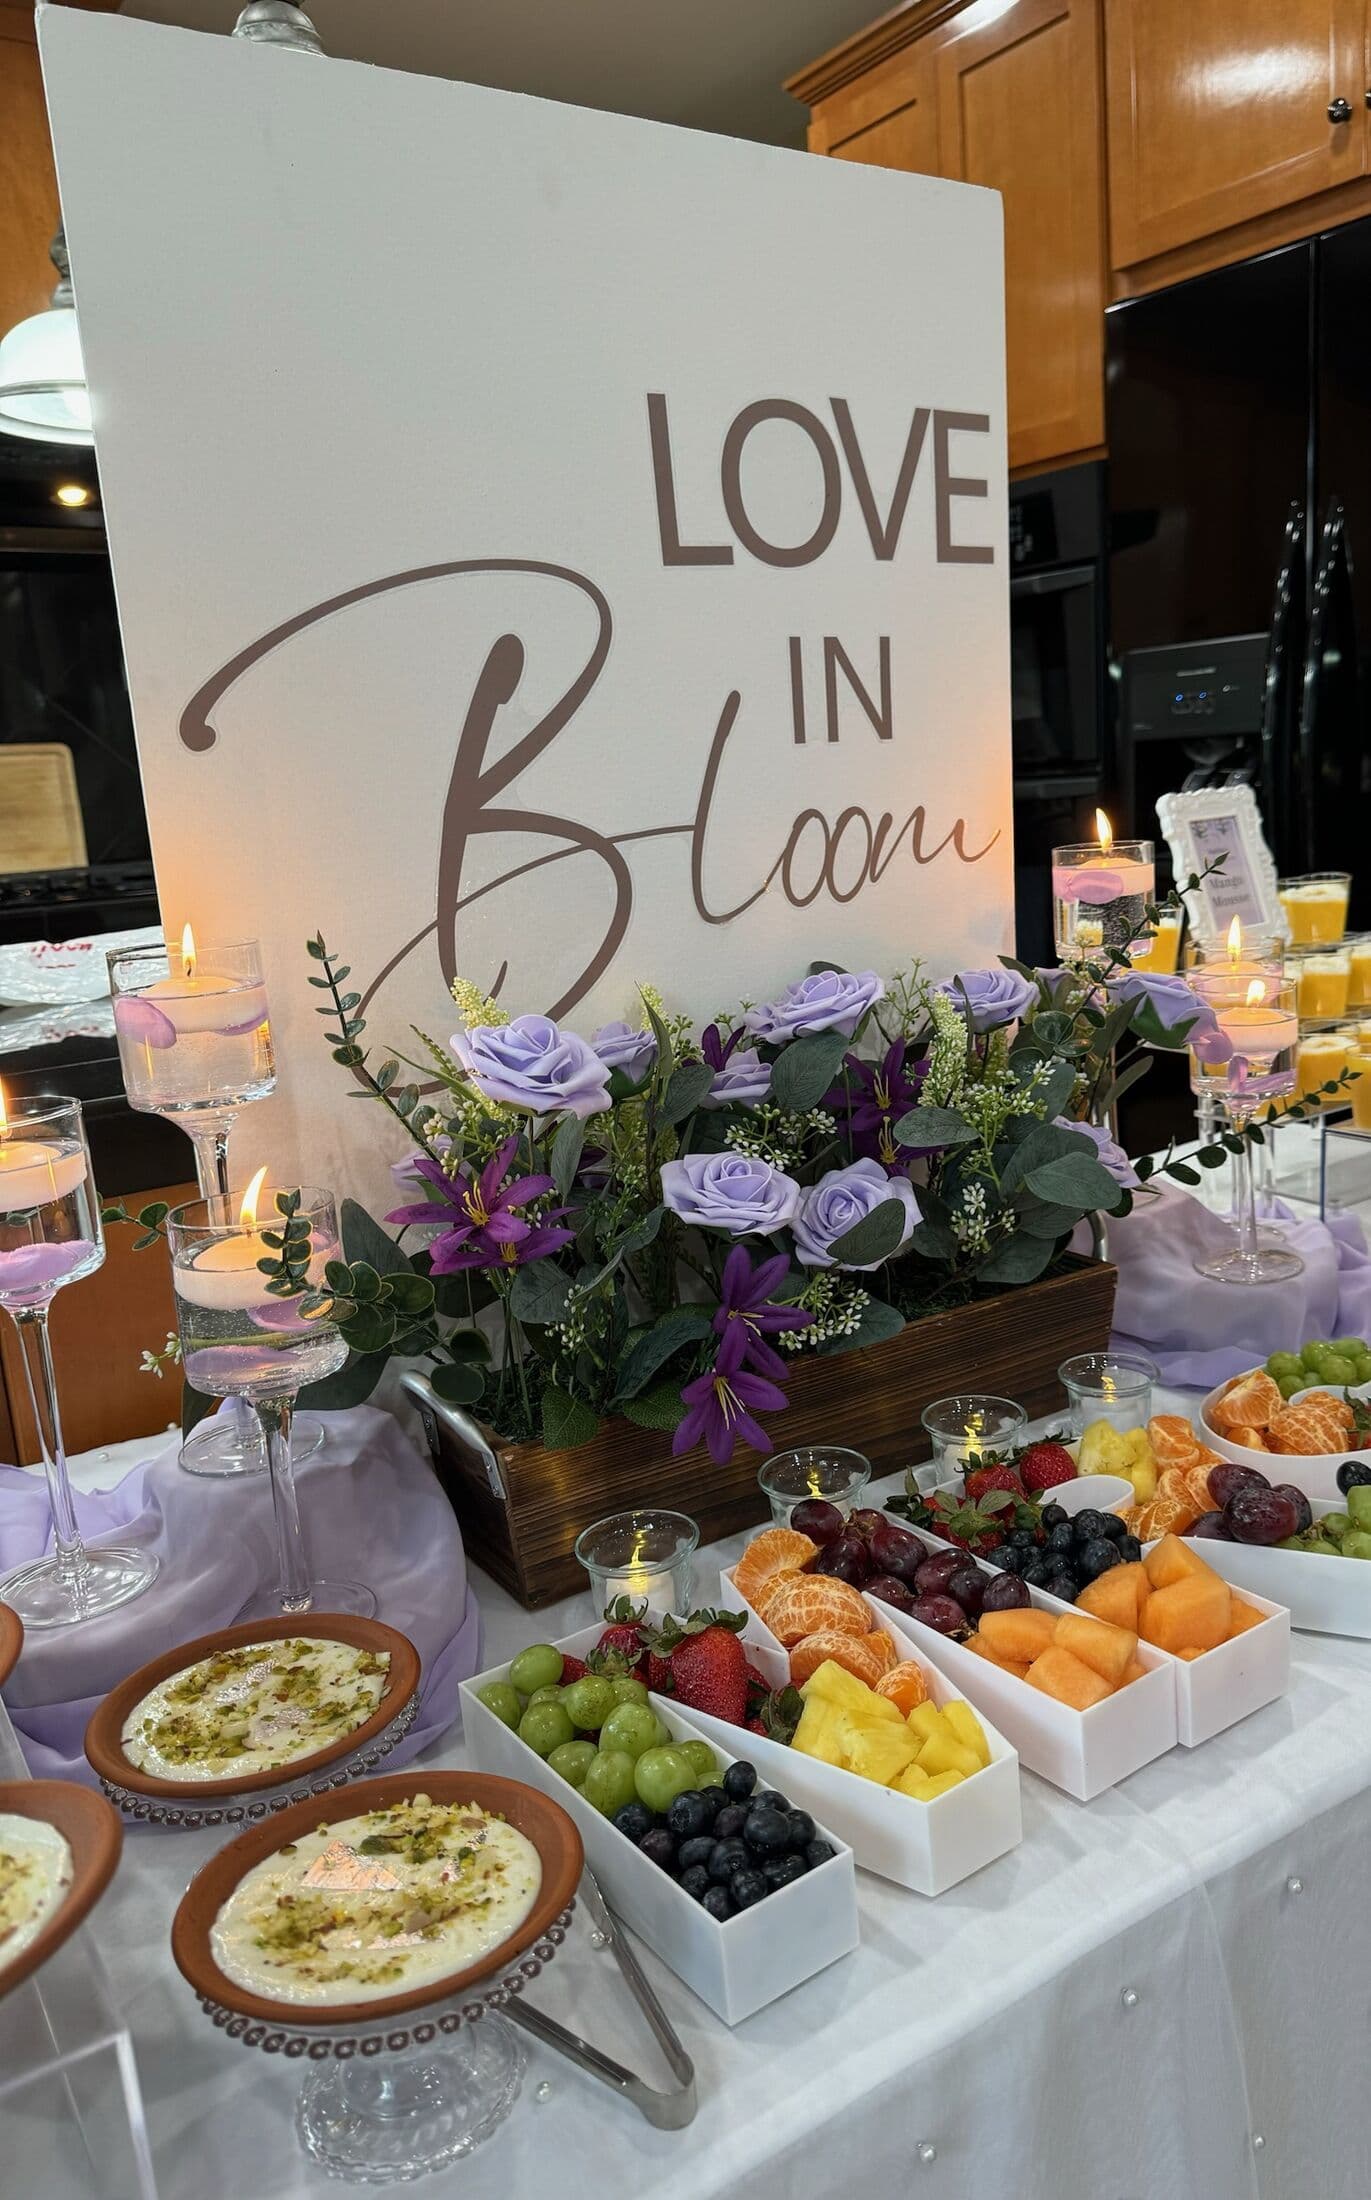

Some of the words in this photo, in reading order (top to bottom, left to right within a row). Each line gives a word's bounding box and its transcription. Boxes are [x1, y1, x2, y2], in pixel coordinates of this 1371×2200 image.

[646, 393, 994, 568] LOVE
[788, 636, 893, 744] IN
[179, 559, 1001, 1097] Bloom
